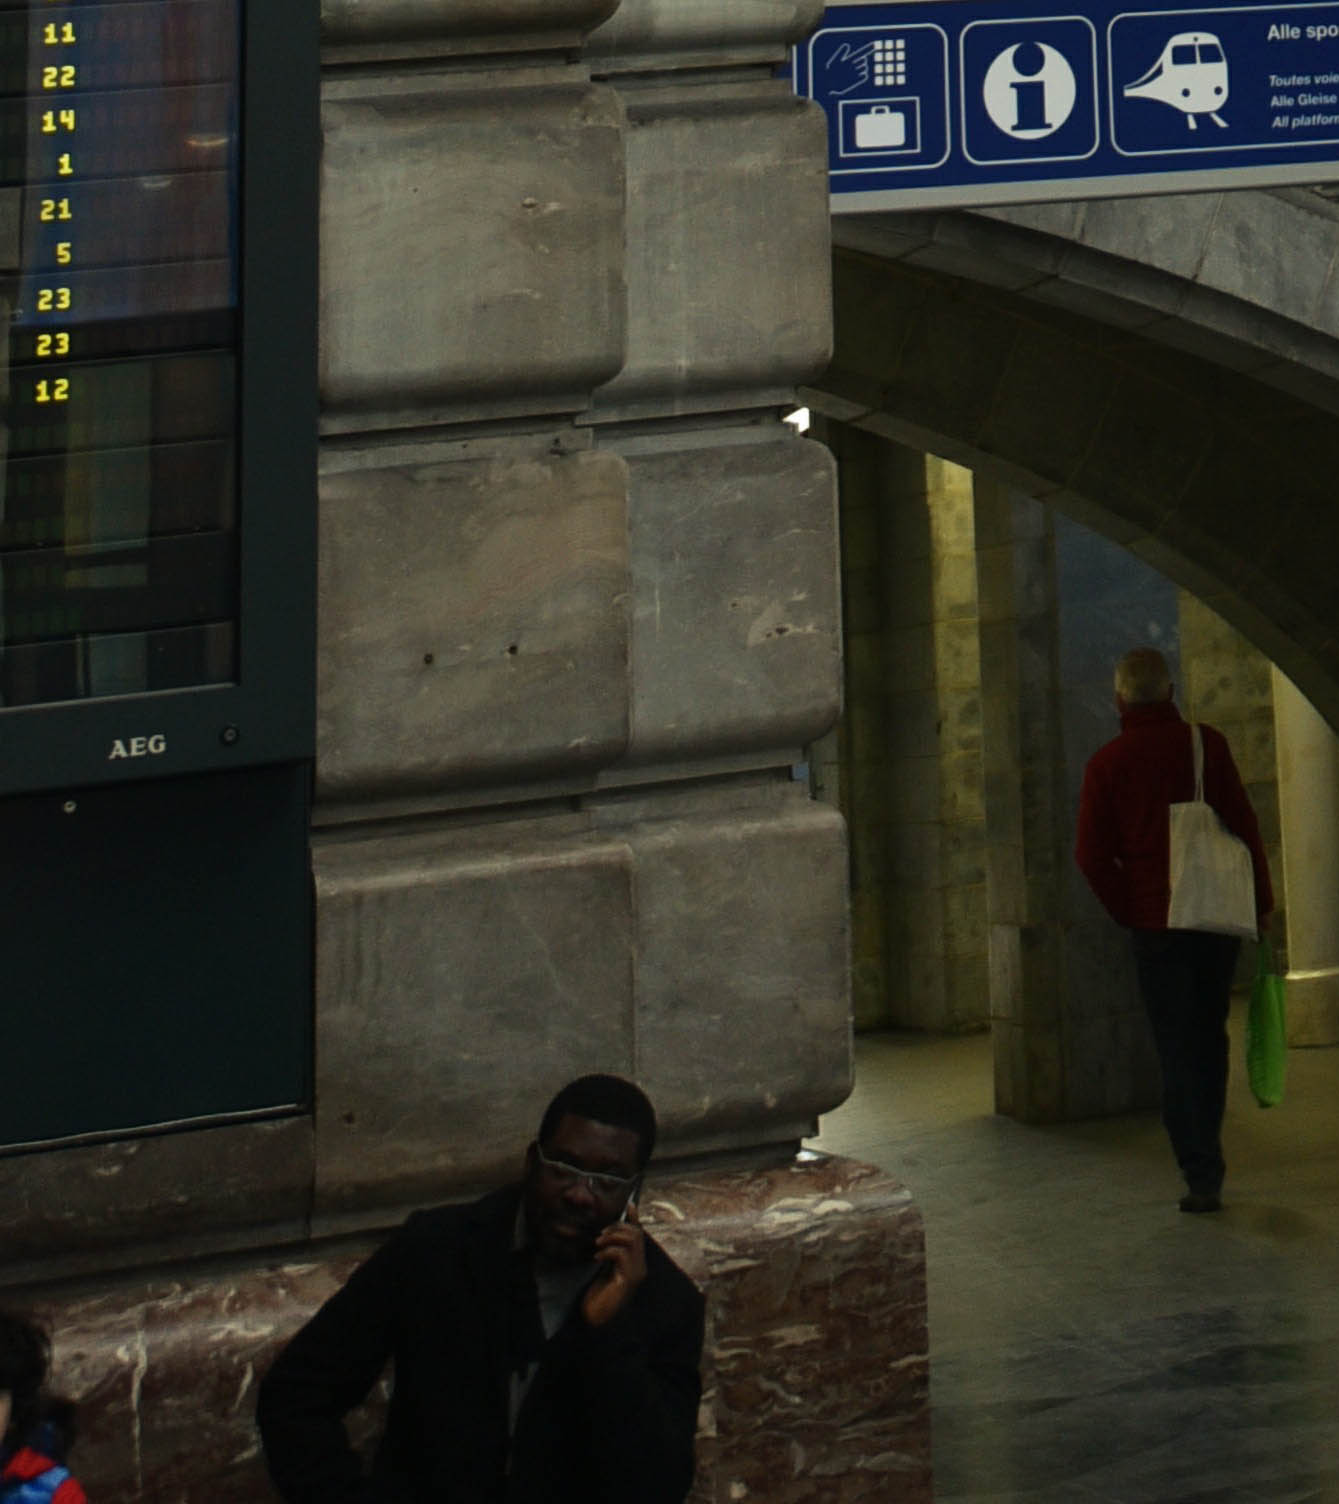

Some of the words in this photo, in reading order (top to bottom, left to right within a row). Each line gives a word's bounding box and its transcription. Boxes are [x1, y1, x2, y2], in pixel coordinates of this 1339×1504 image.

[44, 23, 76, 44] 11
[1267, 25, 1301, 41] Alle
[43, 66, 76, 88] 22
[1269, 74, 1311, 87] Toutes
[1271, 95, 1295, 107] Alle
[1298, 92, 1337, 106] Gleise
[42, 110, 75, 133] 14
[1273, 116, 1289, 128] All
[59, 154, 73, 175] 1
[40, 199, 72, 221] 21
[57, 243, 72, 264] 5
[38, 288, 71, 311] 23
[37, 333, 70, 356] 23
[36, 378, 69, 402] 12
[109, 734, 166, 760] AEG
